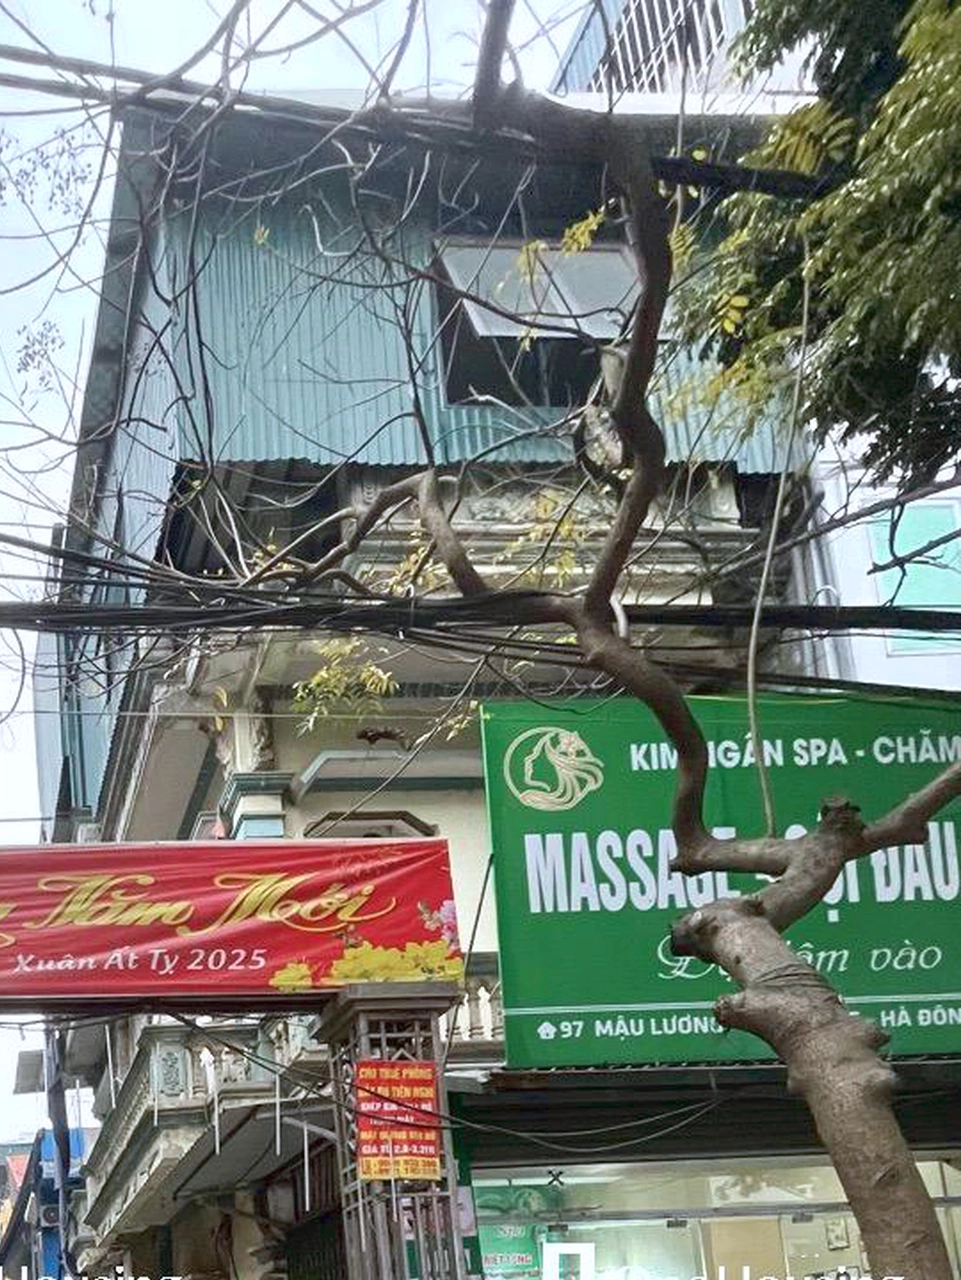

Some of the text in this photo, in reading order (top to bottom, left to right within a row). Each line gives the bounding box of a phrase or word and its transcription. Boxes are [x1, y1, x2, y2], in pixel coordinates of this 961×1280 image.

[793, 737, 848, 766] SPA
[873, 728, 961, 764] CHĂM
[21, 873, 194, 929] Năm
[176, 871, 398, 938] Mới
[13, 953, 98, 974] Xuân
[186, 948, 268, 971] 2025
[869, 940, 942, 970] vào
[561, 1020, 584, 1038] 97
[595, 1014, 644, 1041] MẬU
[880, 1005, 912, 1027] HÀ
